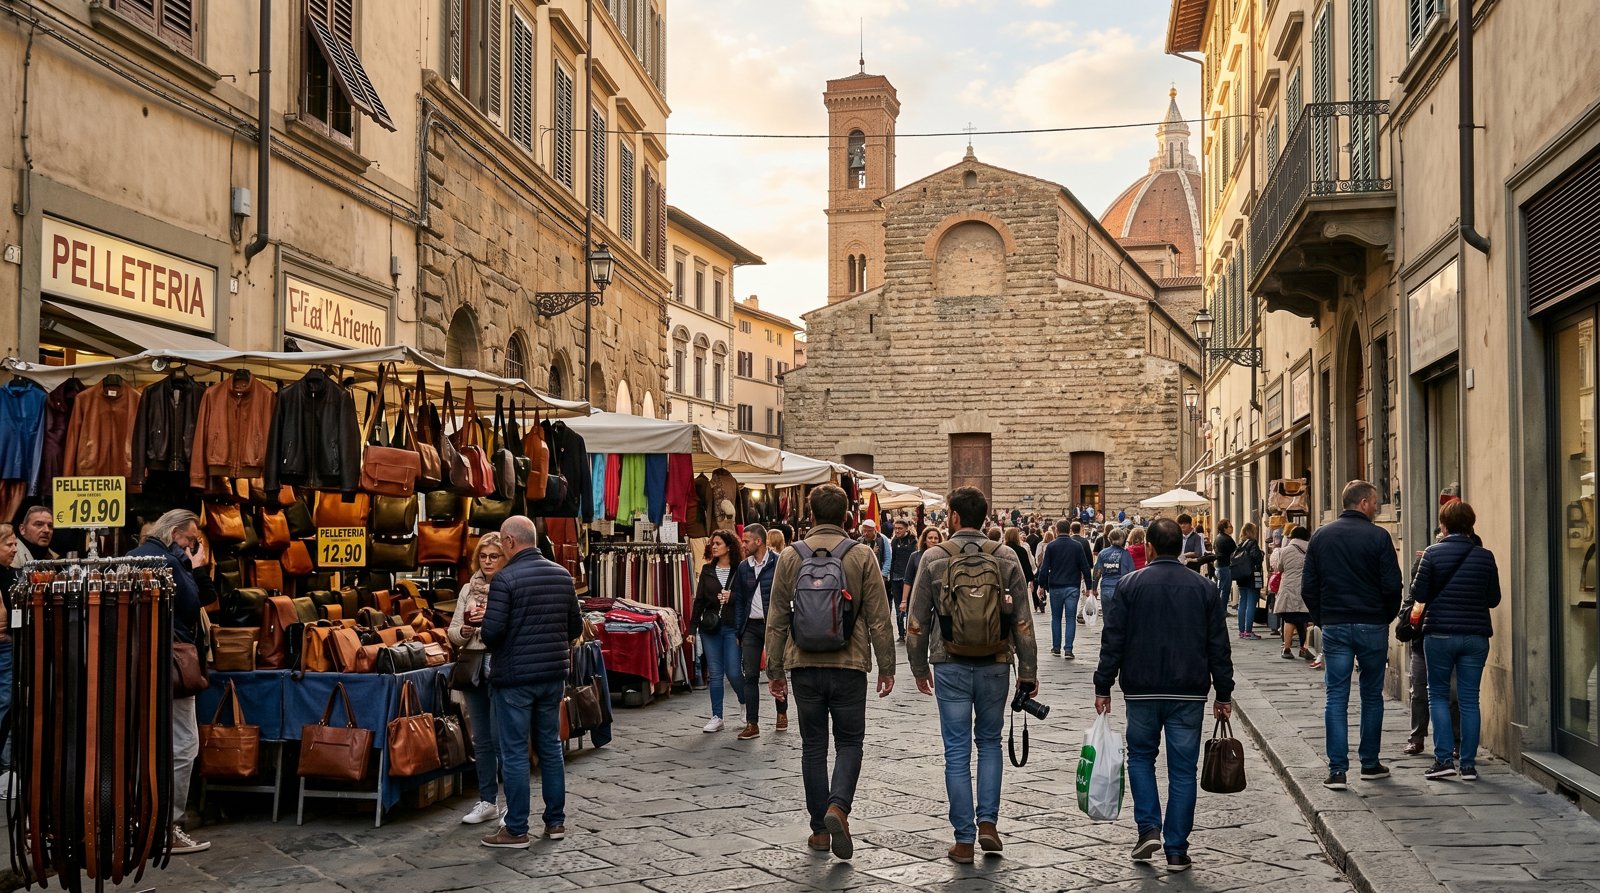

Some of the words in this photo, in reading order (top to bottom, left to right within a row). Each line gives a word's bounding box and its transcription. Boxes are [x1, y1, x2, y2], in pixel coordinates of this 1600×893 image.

[52, 233, 205, 318] PELLETERIA
[56, 479, 122, 491] PELLETERIA
[56, 510, 64, 523] €
[69, 498, 120, 522] 19.90
[320, 528, 364, 538] PELLETERIA
[323, 543, 362, 563] 12.90
